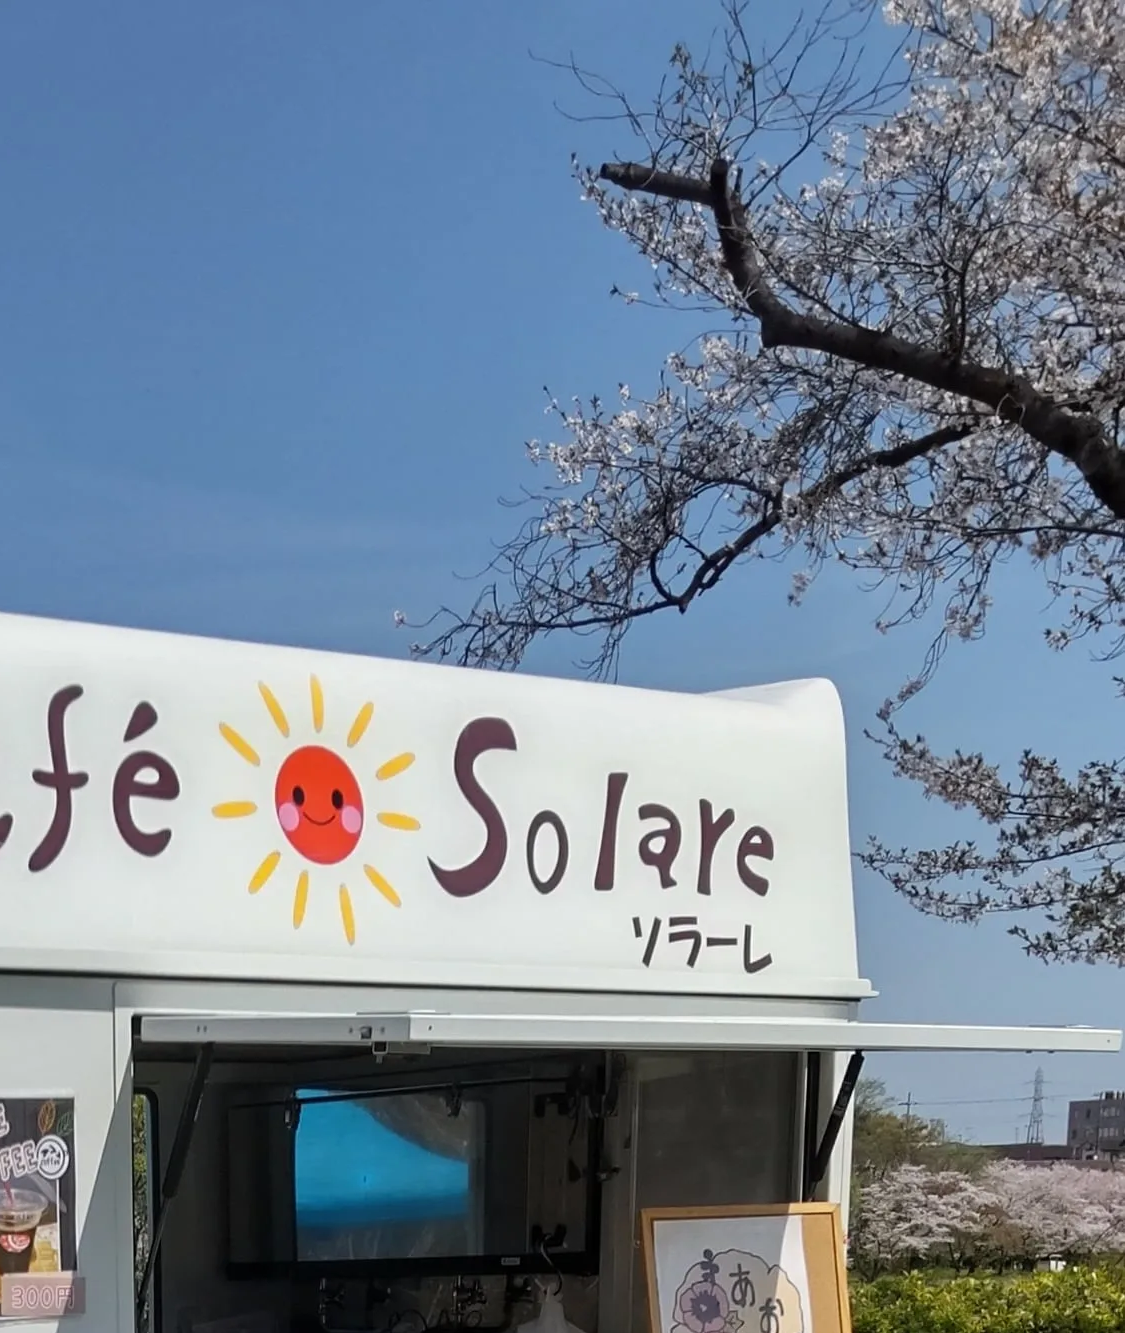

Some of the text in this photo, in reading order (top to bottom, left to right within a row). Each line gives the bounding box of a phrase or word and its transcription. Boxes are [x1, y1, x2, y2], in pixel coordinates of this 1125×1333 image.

[426, 717, 774, 898] Solare
[632, 916, 772, 974] ソラーレ
[11, 1284, 76, 1309] 300円
